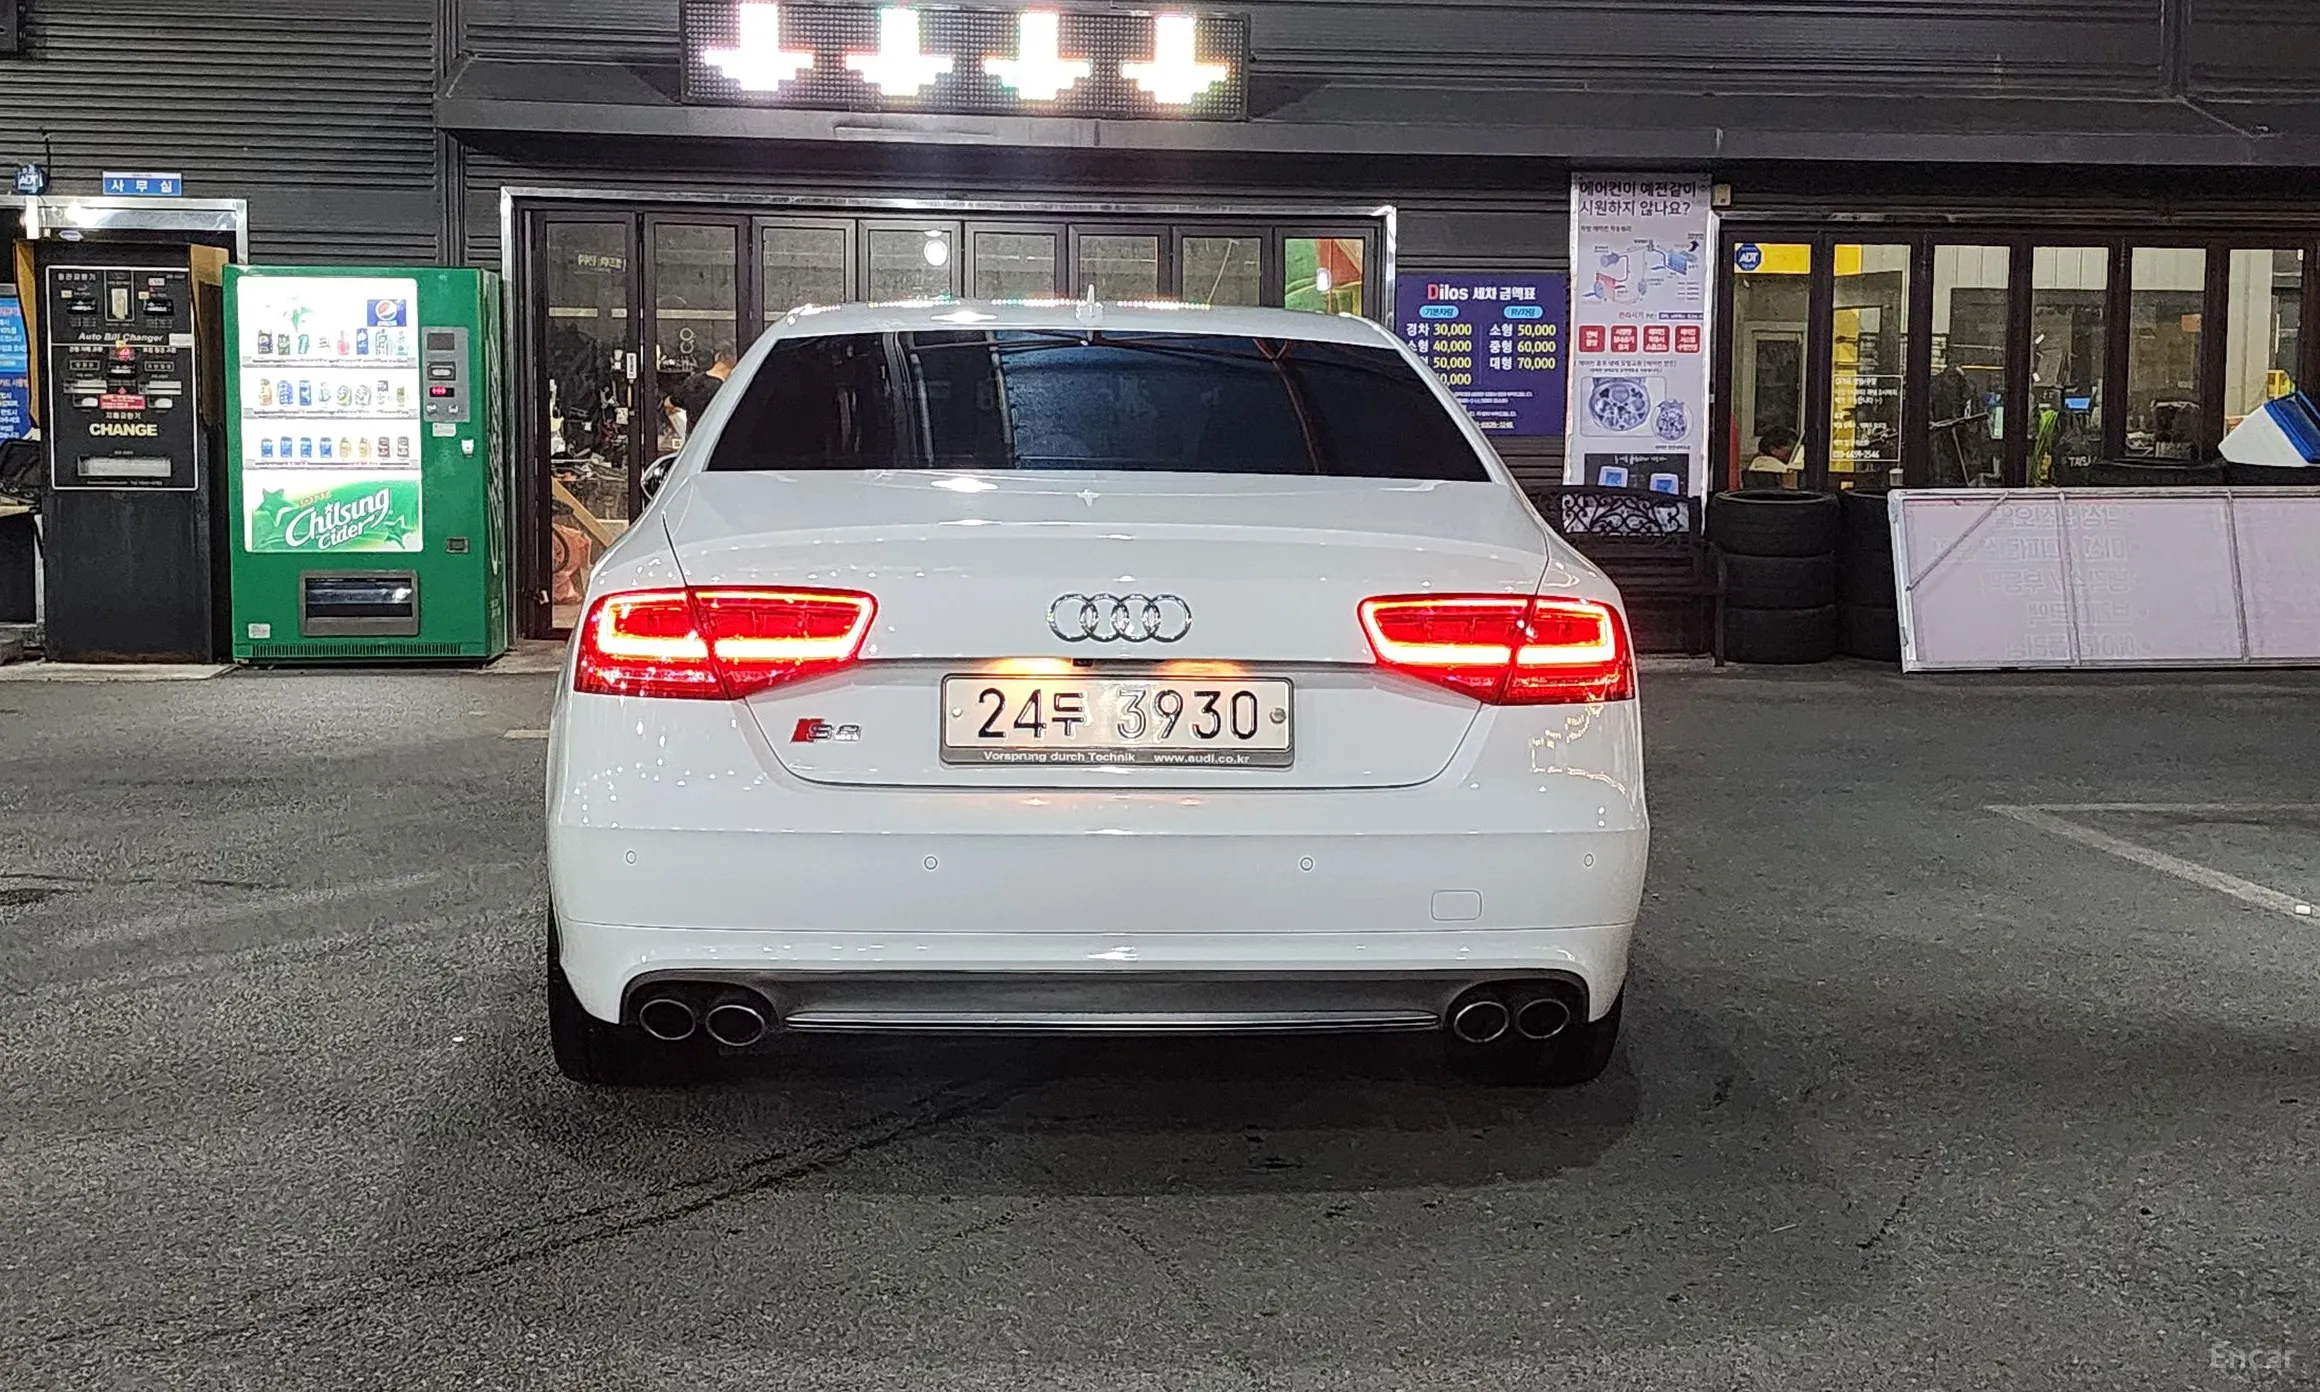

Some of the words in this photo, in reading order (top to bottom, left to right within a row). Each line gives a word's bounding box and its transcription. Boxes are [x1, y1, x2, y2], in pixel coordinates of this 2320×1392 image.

[111, 179, 173, 193] 사무실
[1580, 181, 1636, 197] 에어컨이
[1641, 181, 1696, 197] 예전같이
[1580, 200, 1635, 216] 시원하지
[1640, 200, 1691, 216] 않나요?
[1738, 252, 1758, 263] ADT
[1427, 284, 1469, 300] Dilos
[1472, 286, 1497, 300] 세차
[1500, 286, 1536, 300] 금액표
[1406, 323, 1429, 336] 경차
[1433, 323, 1472, 337] 30,000
[1489, 323, 1513, 336] 소형
[1517, 324, 1557, 337] 50,000
[78, 332, 102, 341] Auto
[104, 332, 121, 341] Bill
[122, 333, 164, 343] Changer
[1433, 340, 1472, 354] 40,000
[1489, 341, 1513, 353] 중형
[1517, 341, 1557, 354] 60,000
[1433, 357, 1472, 370] 50,000
[1489, 357, 1513, 370] 대형
[1517, 357, 1556, 371] 70,000
[1439, 373, 1472, 386] 0,000
[89, 423, 158, 437] CHANGE
[285, 488, 390, 547] Chilsung
[317, 515, 375, 550] Cider
[977, 687, 1085, 739] 24두
[1116, 688, 1258, 740] 3930
[807, 723, 861, 741] S8
[983, 751, 1047, 763] Vorsprung
[1050, 751, 1085, 762] durch
[1088, 752, 1136, 762] Technik
[1153, 753, 1250, 764] www.audi.co.kr
